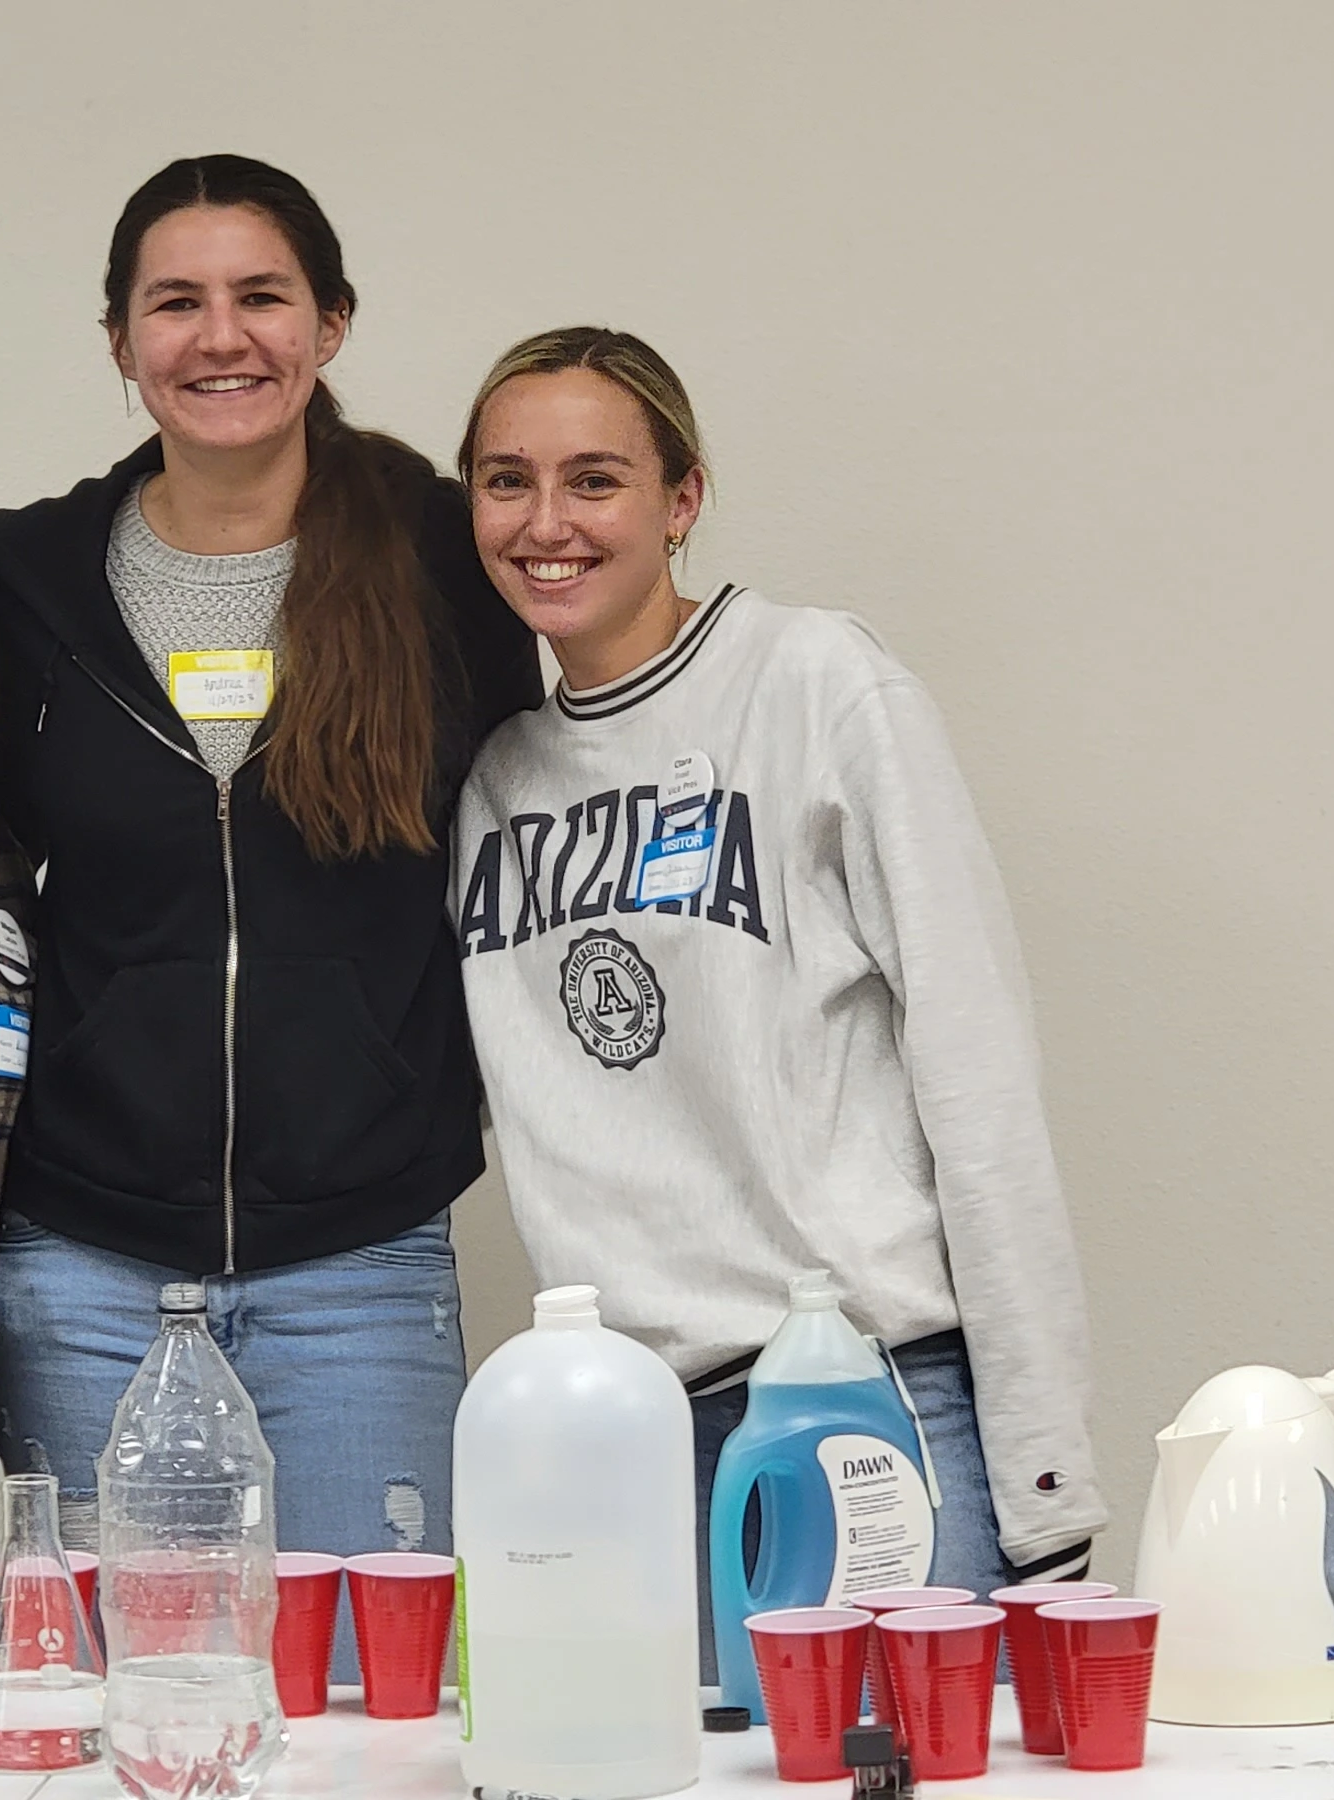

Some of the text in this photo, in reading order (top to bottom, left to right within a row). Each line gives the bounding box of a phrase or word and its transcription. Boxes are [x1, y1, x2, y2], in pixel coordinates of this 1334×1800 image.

[661, 834, 704, 854] VISITOR
[568, 941, 656, 1024] THE UNIVERSITY OF ARIZONA
[593, 967, 634, 1018] A
[592, 1024, 656, 1059] WILDCATS
[843, 1453, 894, 1480] DAWN
